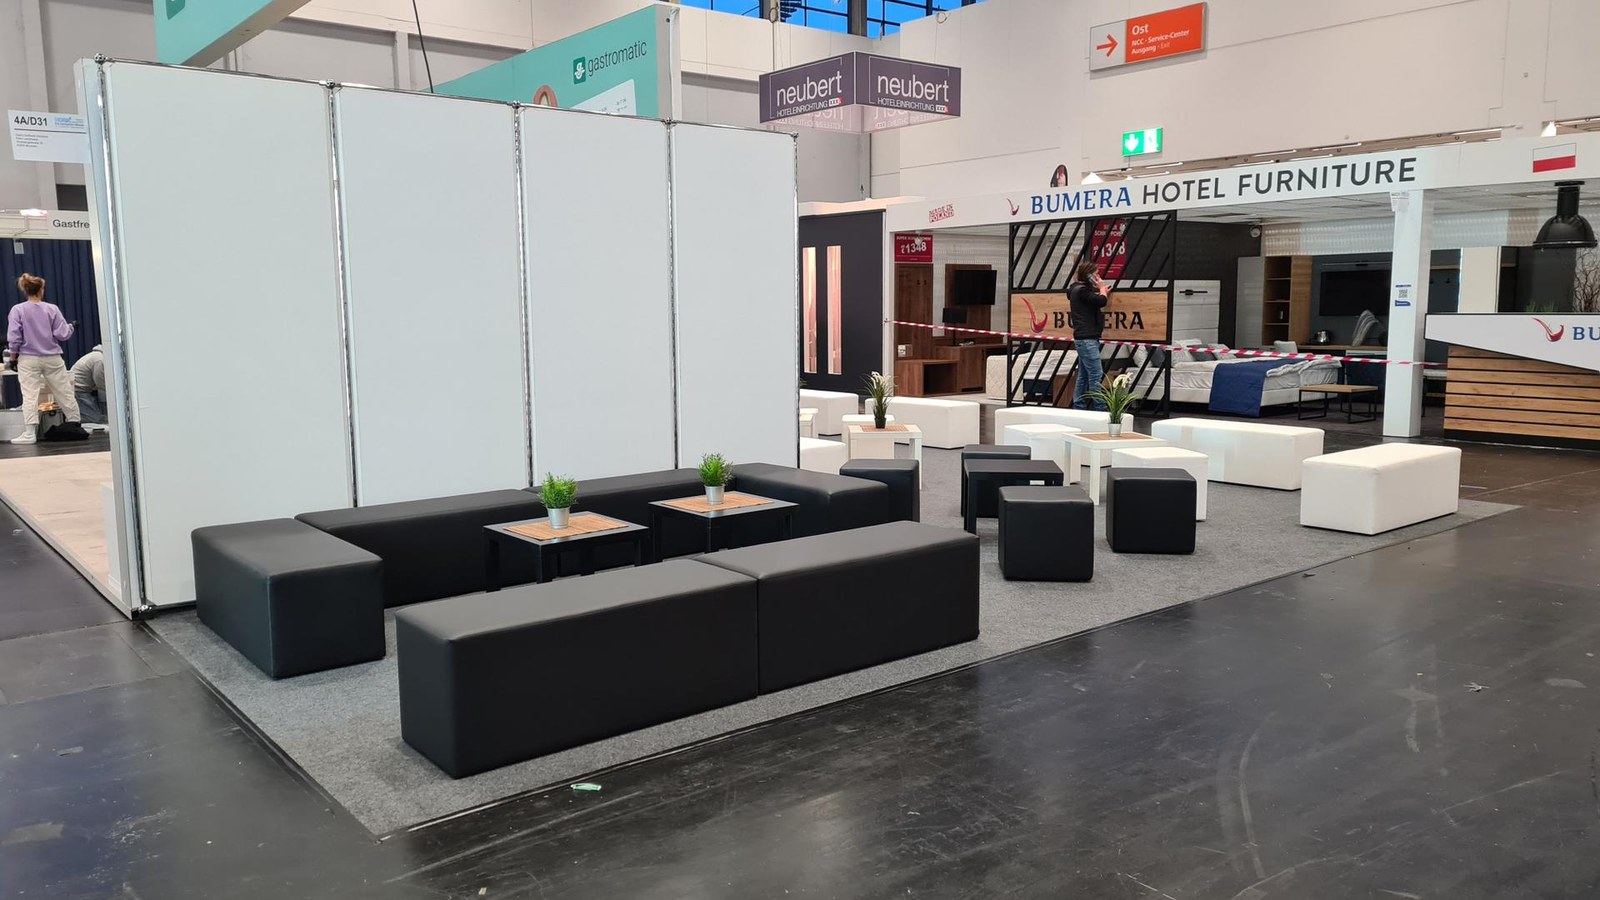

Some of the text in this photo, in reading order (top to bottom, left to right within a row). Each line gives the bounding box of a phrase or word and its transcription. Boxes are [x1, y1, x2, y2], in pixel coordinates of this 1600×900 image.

[1132, 24, 1149, 35] Ost
[1131, 30, 1190, 46] NCC Service-Center
[1131, 45, 1156, 54] Ausgang
[587, 40, 647, 77] gastromatic
[776, 70, 842, 106] neubert
[877, 74, 949, 102] neubert
[776, 101, 828, 118] HOTELEINRICHTUNG
[877, 97, 935, 112] HOTELEINRICHTUNG
[14, 115, 48, 126] 4A/D31
[1031, 157, 1417, 214] BUMERA HOTEL FURNITURE
[52, 219, 90, 229] Gastfre
[1053, 311, 1144, 329] BUERA
[1572, 326, 1600, 341] BU
